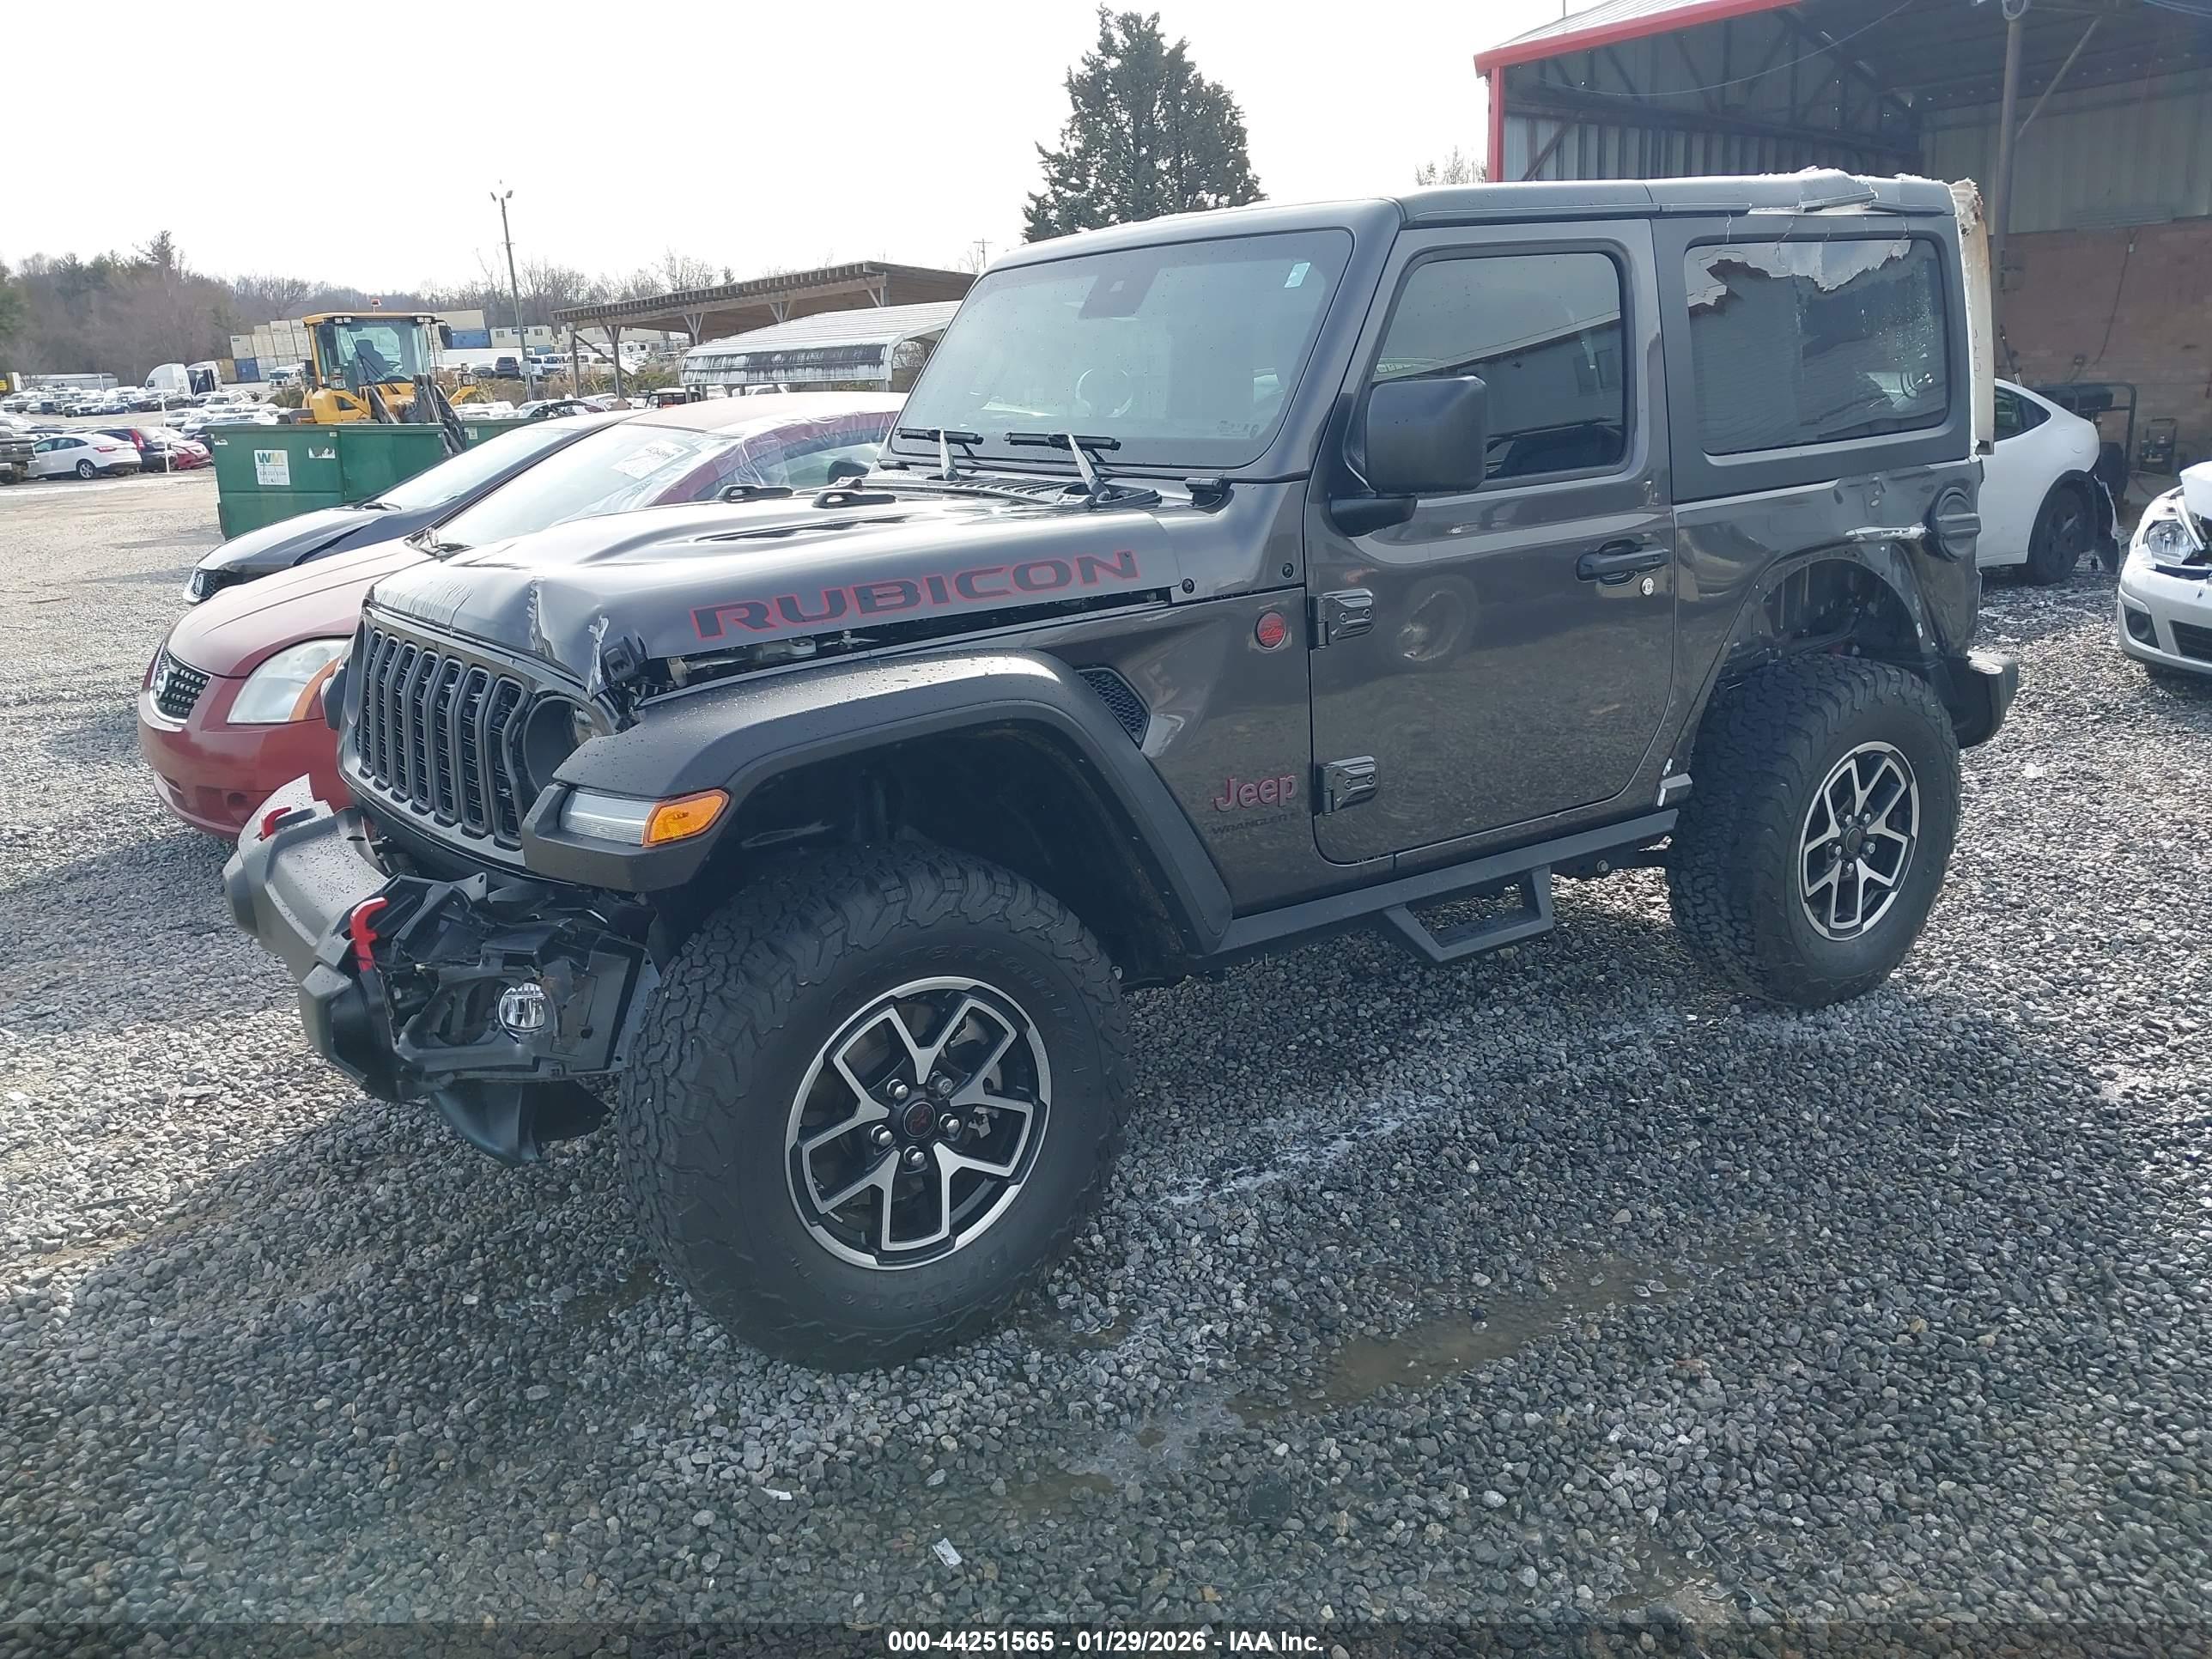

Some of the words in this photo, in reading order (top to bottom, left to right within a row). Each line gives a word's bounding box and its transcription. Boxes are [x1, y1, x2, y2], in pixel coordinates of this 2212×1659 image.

[690, 550, 1139, 640] RUBICON
[1214, 775, 1299, 812] Jeep
[1211, 814, 1288, 835] WRANGLER
